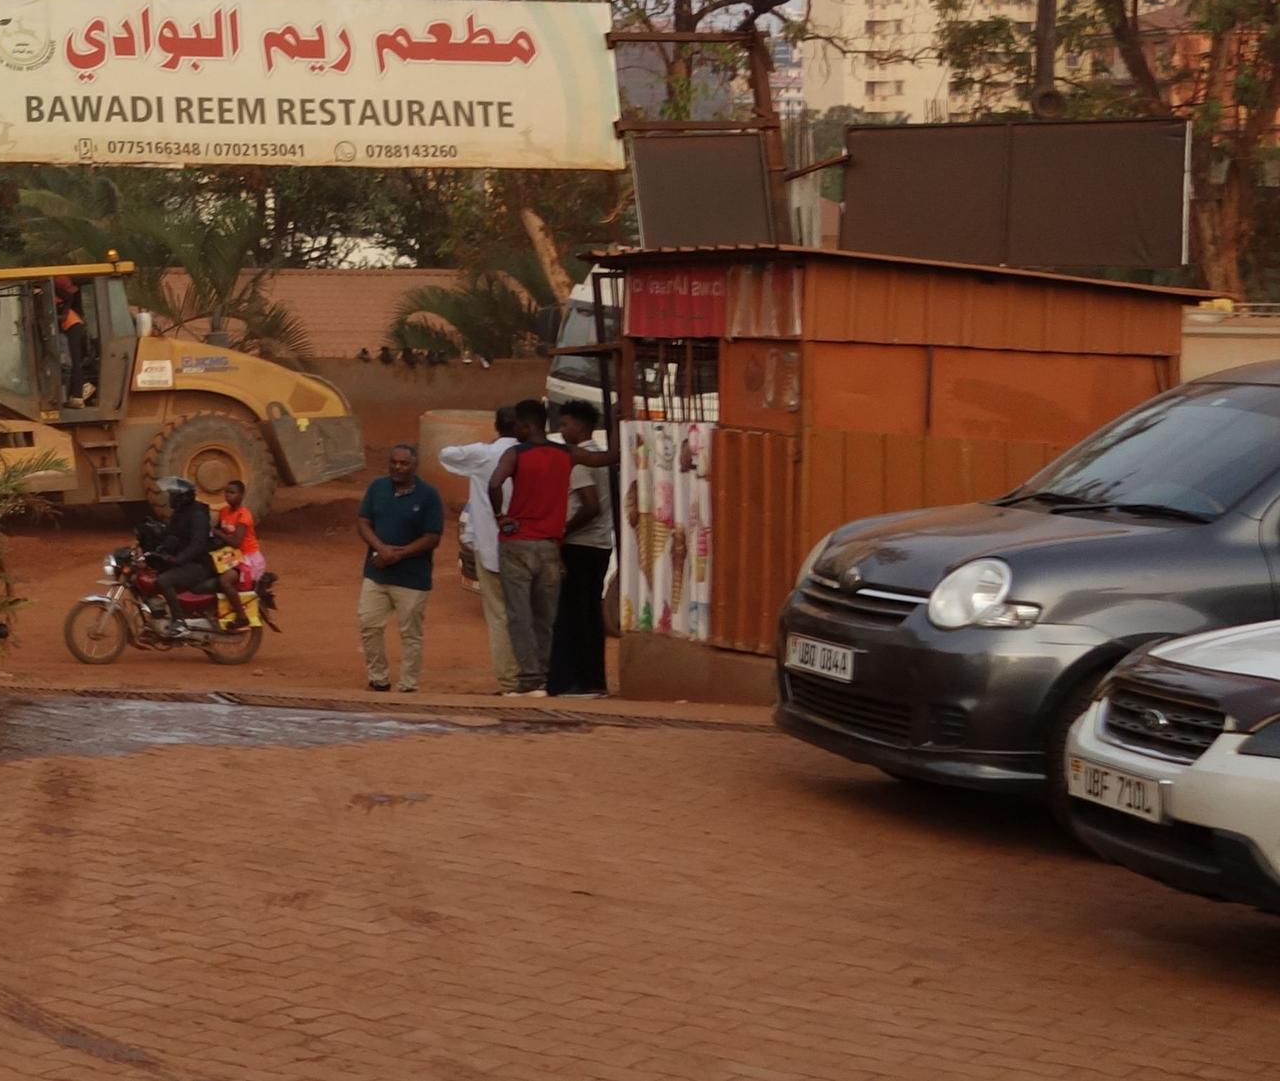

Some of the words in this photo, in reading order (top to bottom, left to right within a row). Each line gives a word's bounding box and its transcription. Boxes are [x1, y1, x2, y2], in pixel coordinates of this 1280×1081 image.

[65, 8, 240, 81] البوادي
[263, 25, 352, 72] ريم
[375, 17, 536, 71] مطعم
[25, 95, 164, 123] BAWADI
[174, 97, 266, 125] REEM
[277, 98, 515, 129] RESTAURANTE
[107, 140, 202, 156] 0775166348
[213, 143, 305, 158] 0702153041
[365, 144, 458, 159] 0788143260
